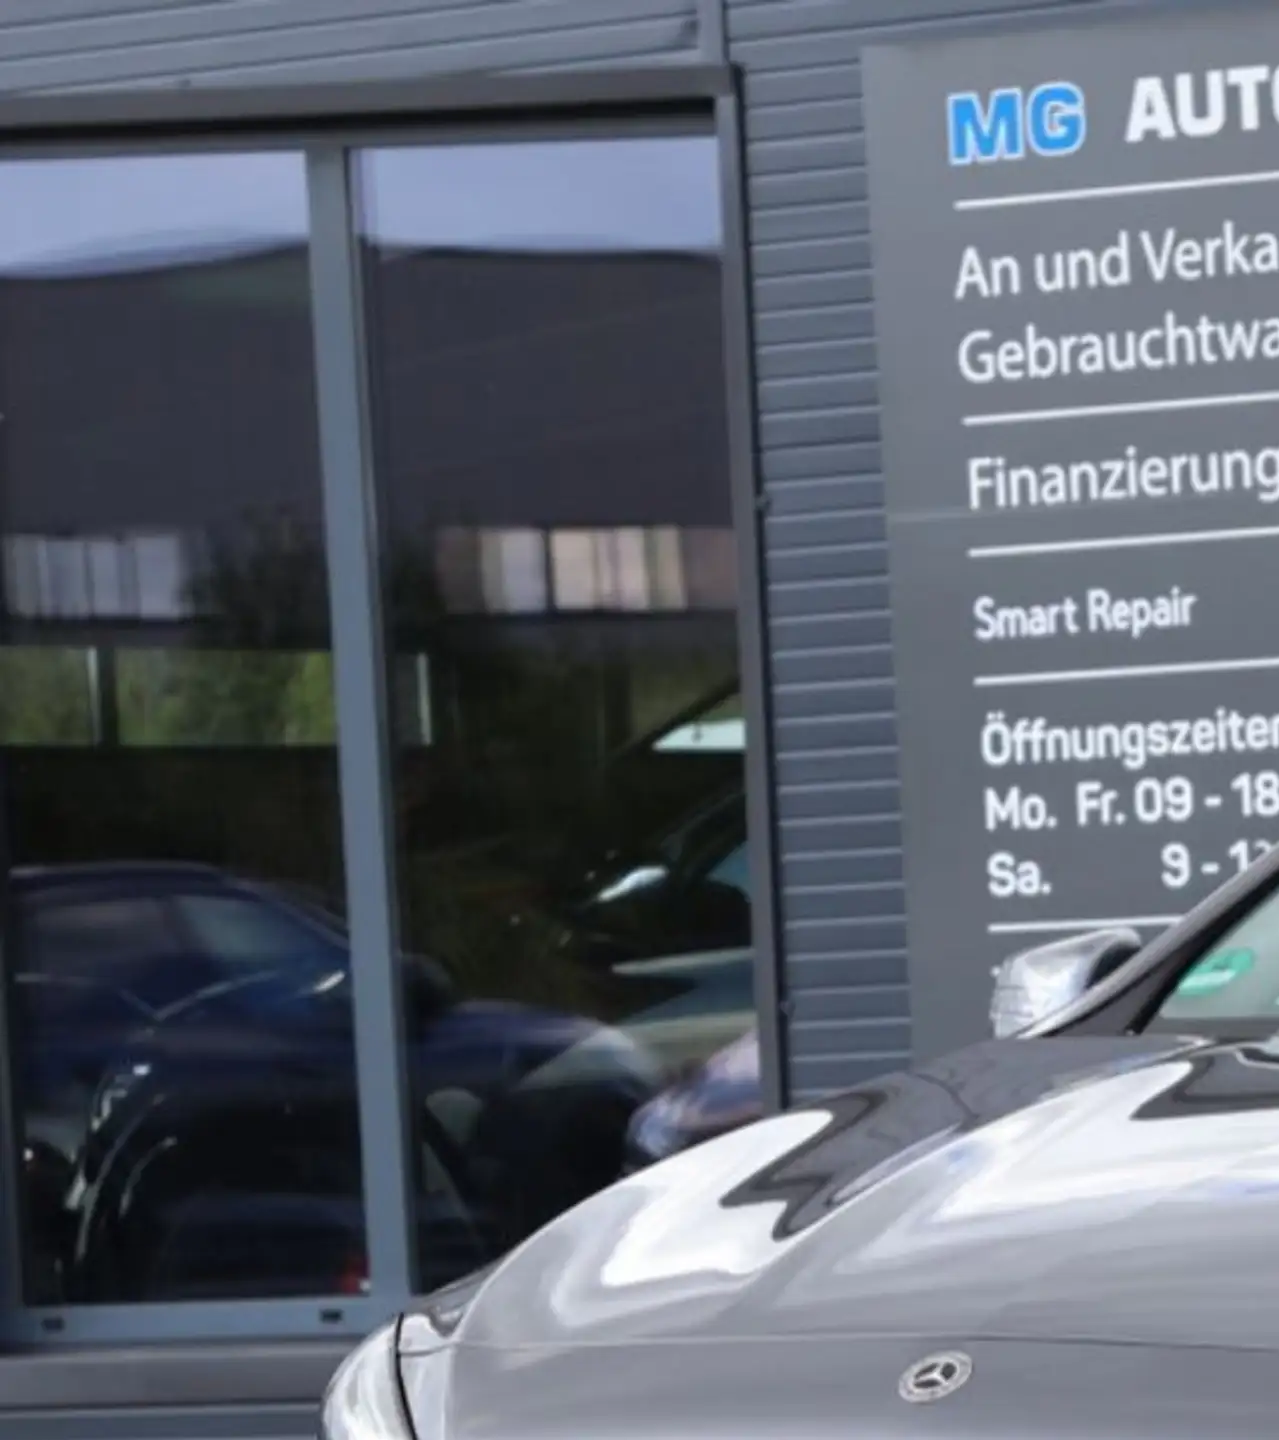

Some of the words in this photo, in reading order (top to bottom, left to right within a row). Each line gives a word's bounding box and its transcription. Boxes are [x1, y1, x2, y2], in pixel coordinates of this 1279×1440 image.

[946, 80, 1087, 166] MG
[954, 246, 1021, 299] An
[1034, 231, 1131, 293] und
[974, 595, 1078, 641] Smart
[1087, 587, 1197, 639] Repair
[985, 786, 1057, 831] Mo.
[1076, 781, 1126, 826] Fr.
[1134, 776, 1194, 823] 09
[987, 851, 1052, 898] Sa.
[1160, 842, 1191, 888] 9
